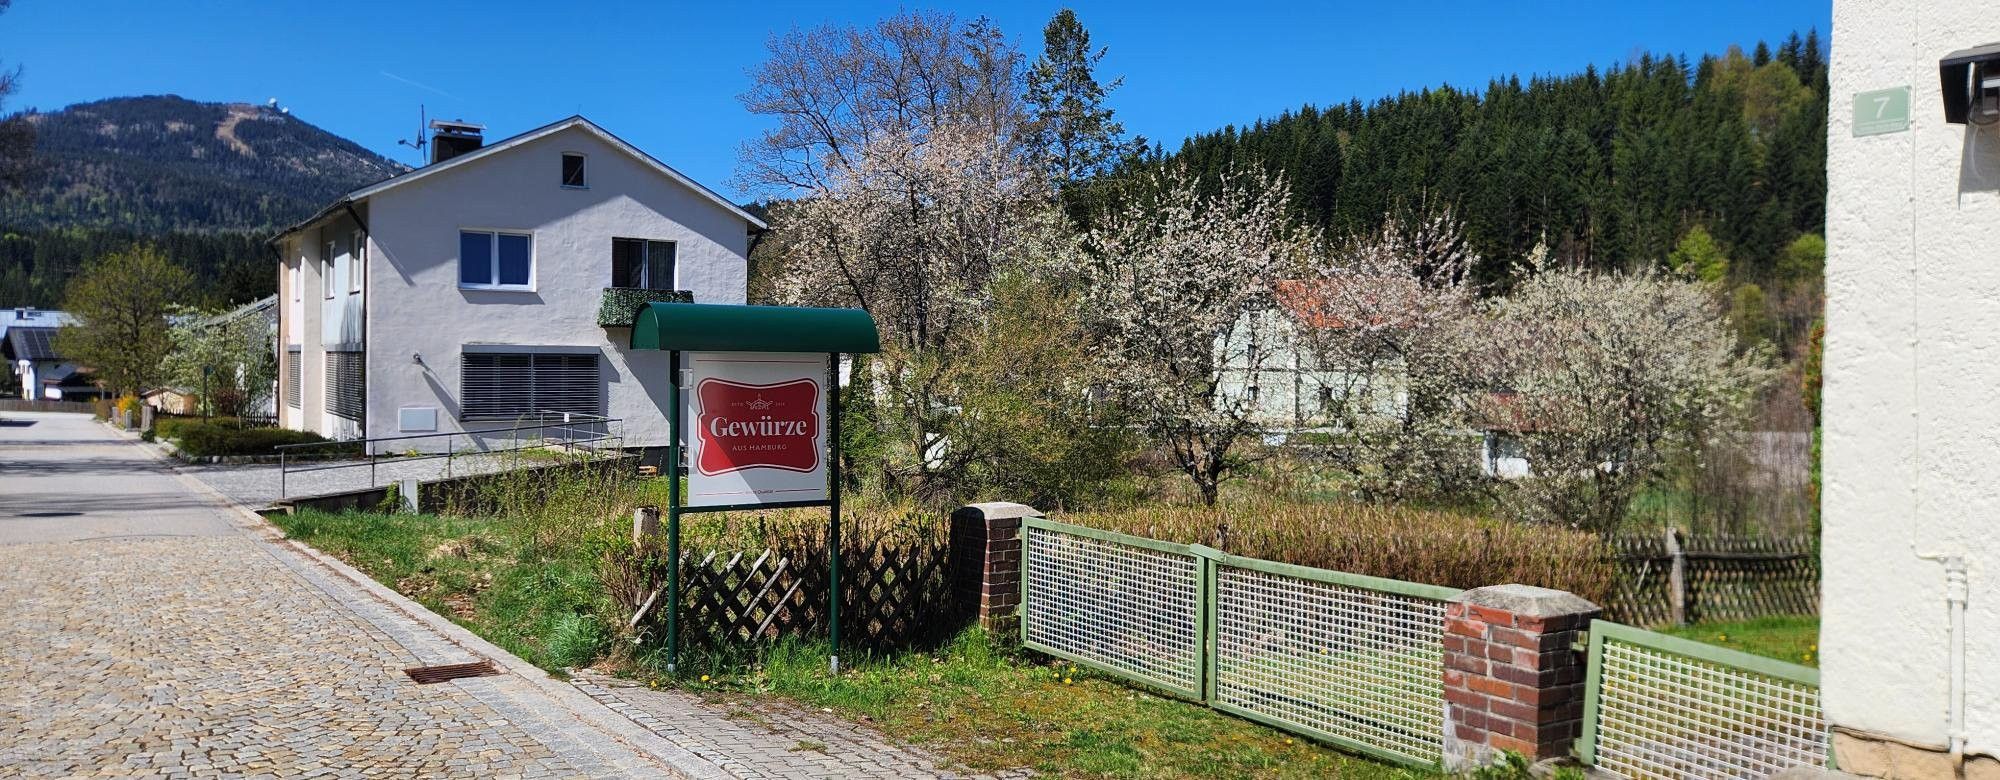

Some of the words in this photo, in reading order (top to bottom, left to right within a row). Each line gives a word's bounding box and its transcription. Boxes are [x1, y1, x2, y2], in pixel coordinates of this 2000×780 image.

[1873, 96, 1890, 118] 7
[710, 415, 807, 437] Gewürze
[749, 443, 787, 451] HAMBURG
